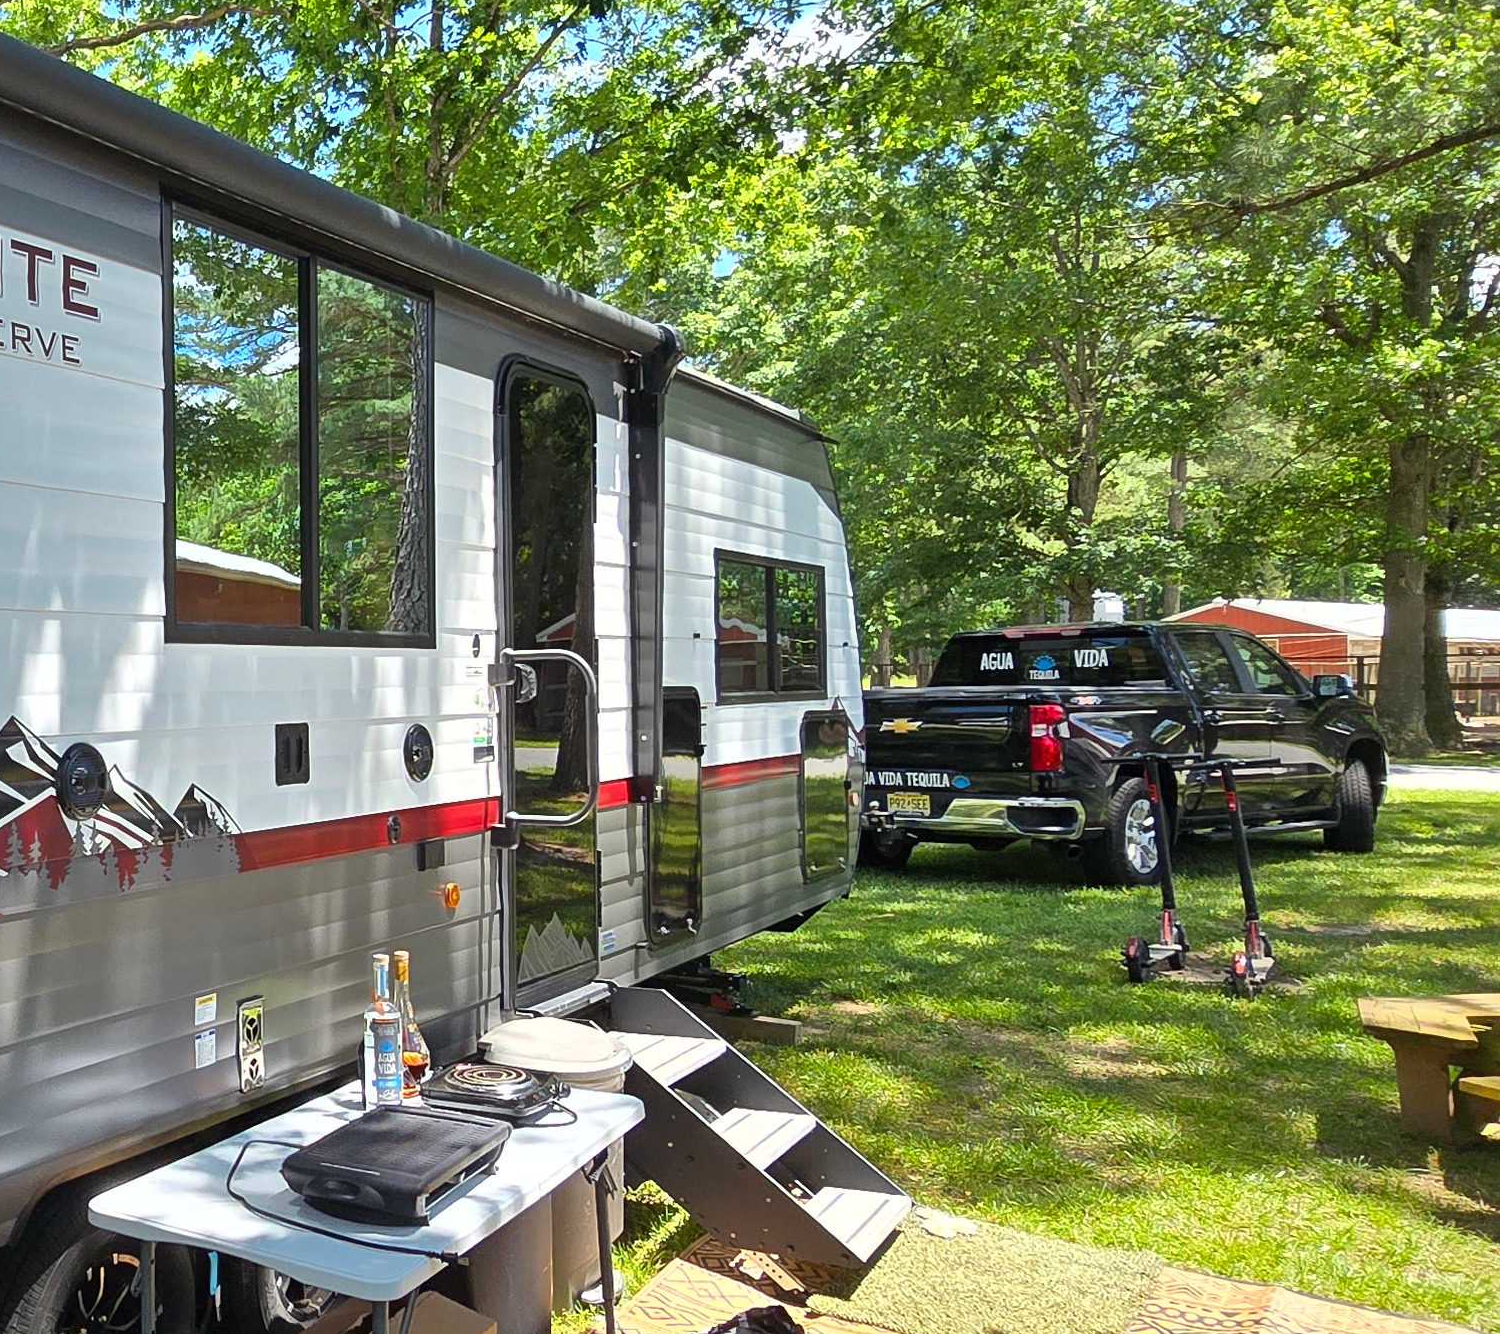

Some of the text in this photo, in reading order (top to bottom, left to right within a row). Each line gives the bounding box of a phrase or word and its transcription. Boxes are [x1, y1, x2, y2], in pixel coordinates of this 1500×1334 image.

[980, 649, 1109, 671] AGUA VIDA
[1029, 669, 1060, 680] TEQUILA
[878, 771, 903, 786] VIDA
[905, 772, 950, 788] TEQUILA
[378, 1063, 397, 1074] VIDA
